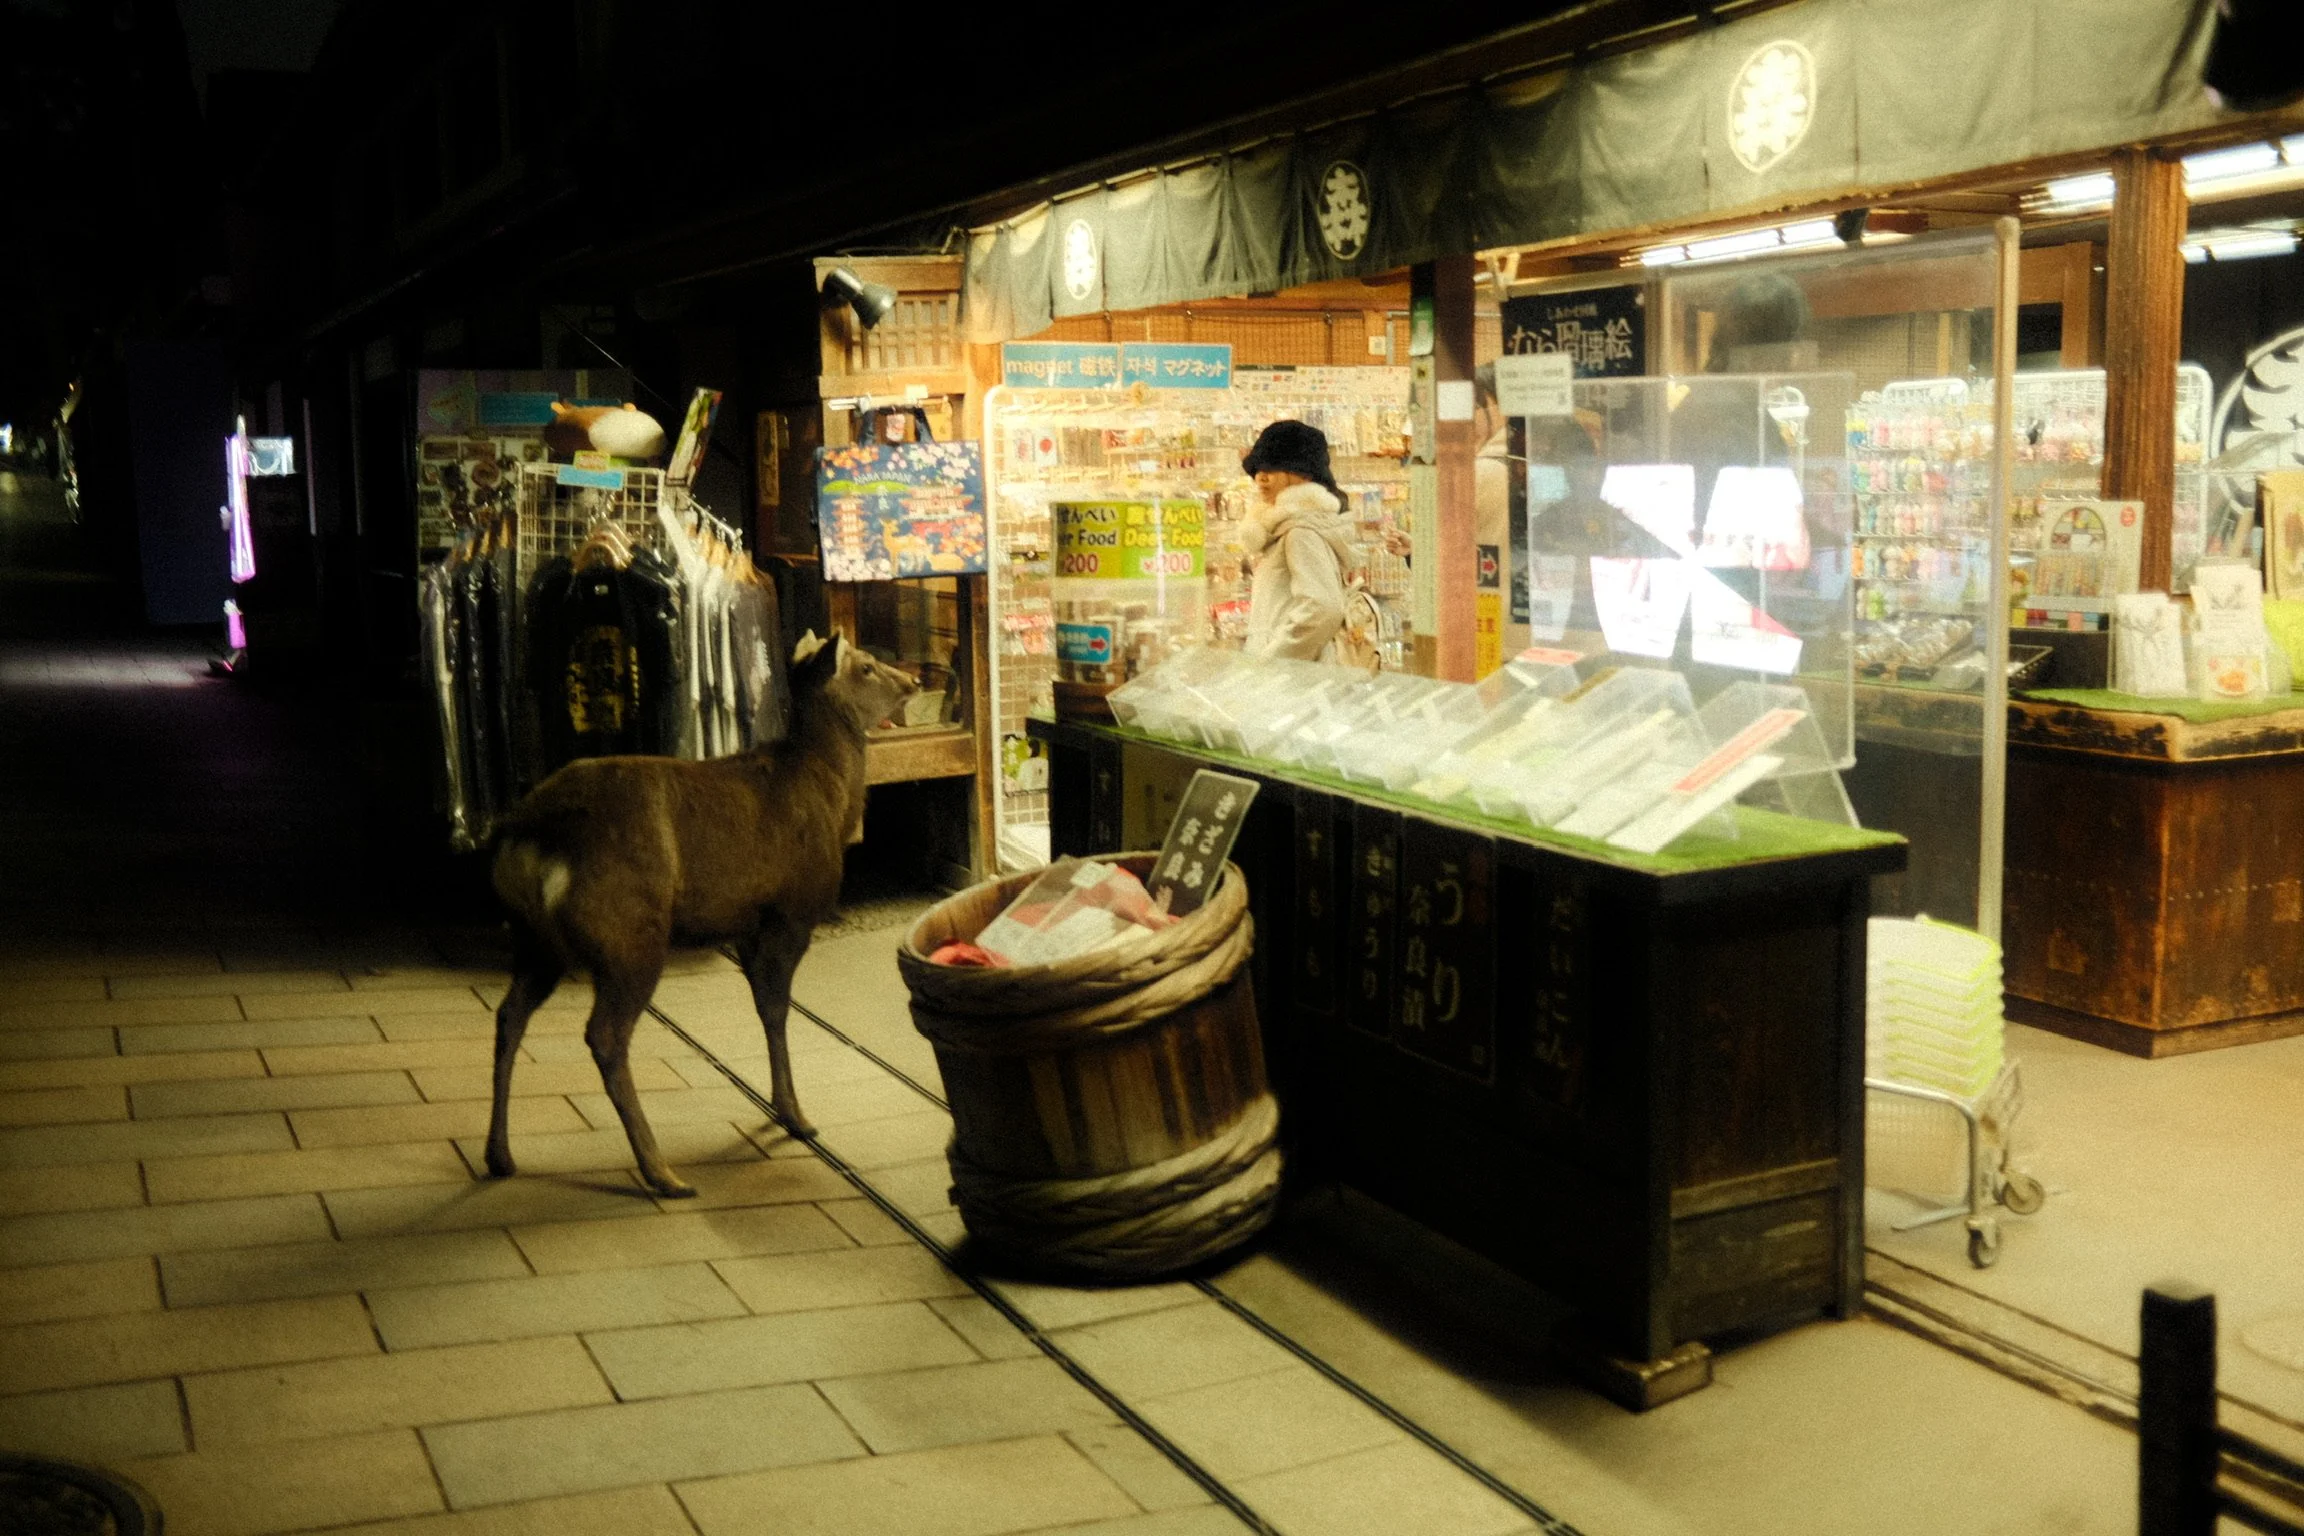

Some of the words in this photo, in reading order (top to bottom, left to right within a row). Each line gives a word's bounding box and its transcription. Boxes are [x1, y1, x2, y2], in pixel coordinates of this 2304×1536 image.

[1005, 357, 1073, 379] magnet
[1126, 356, 1158, 376] 자석
[1163, 358, 1227, 378] マグネット
[853, 472, 881, 486] NARA
[1078, 528, 1117, 546] Food
[1124, 527, 1169, 547] Deer
[1171, 527, 1204, 547] Food
[1183, 791, 1237, 889] きざみ
[1361, 843, 1382, 1001] きゅうり
[1432, 860, 1464, 1023] うり
